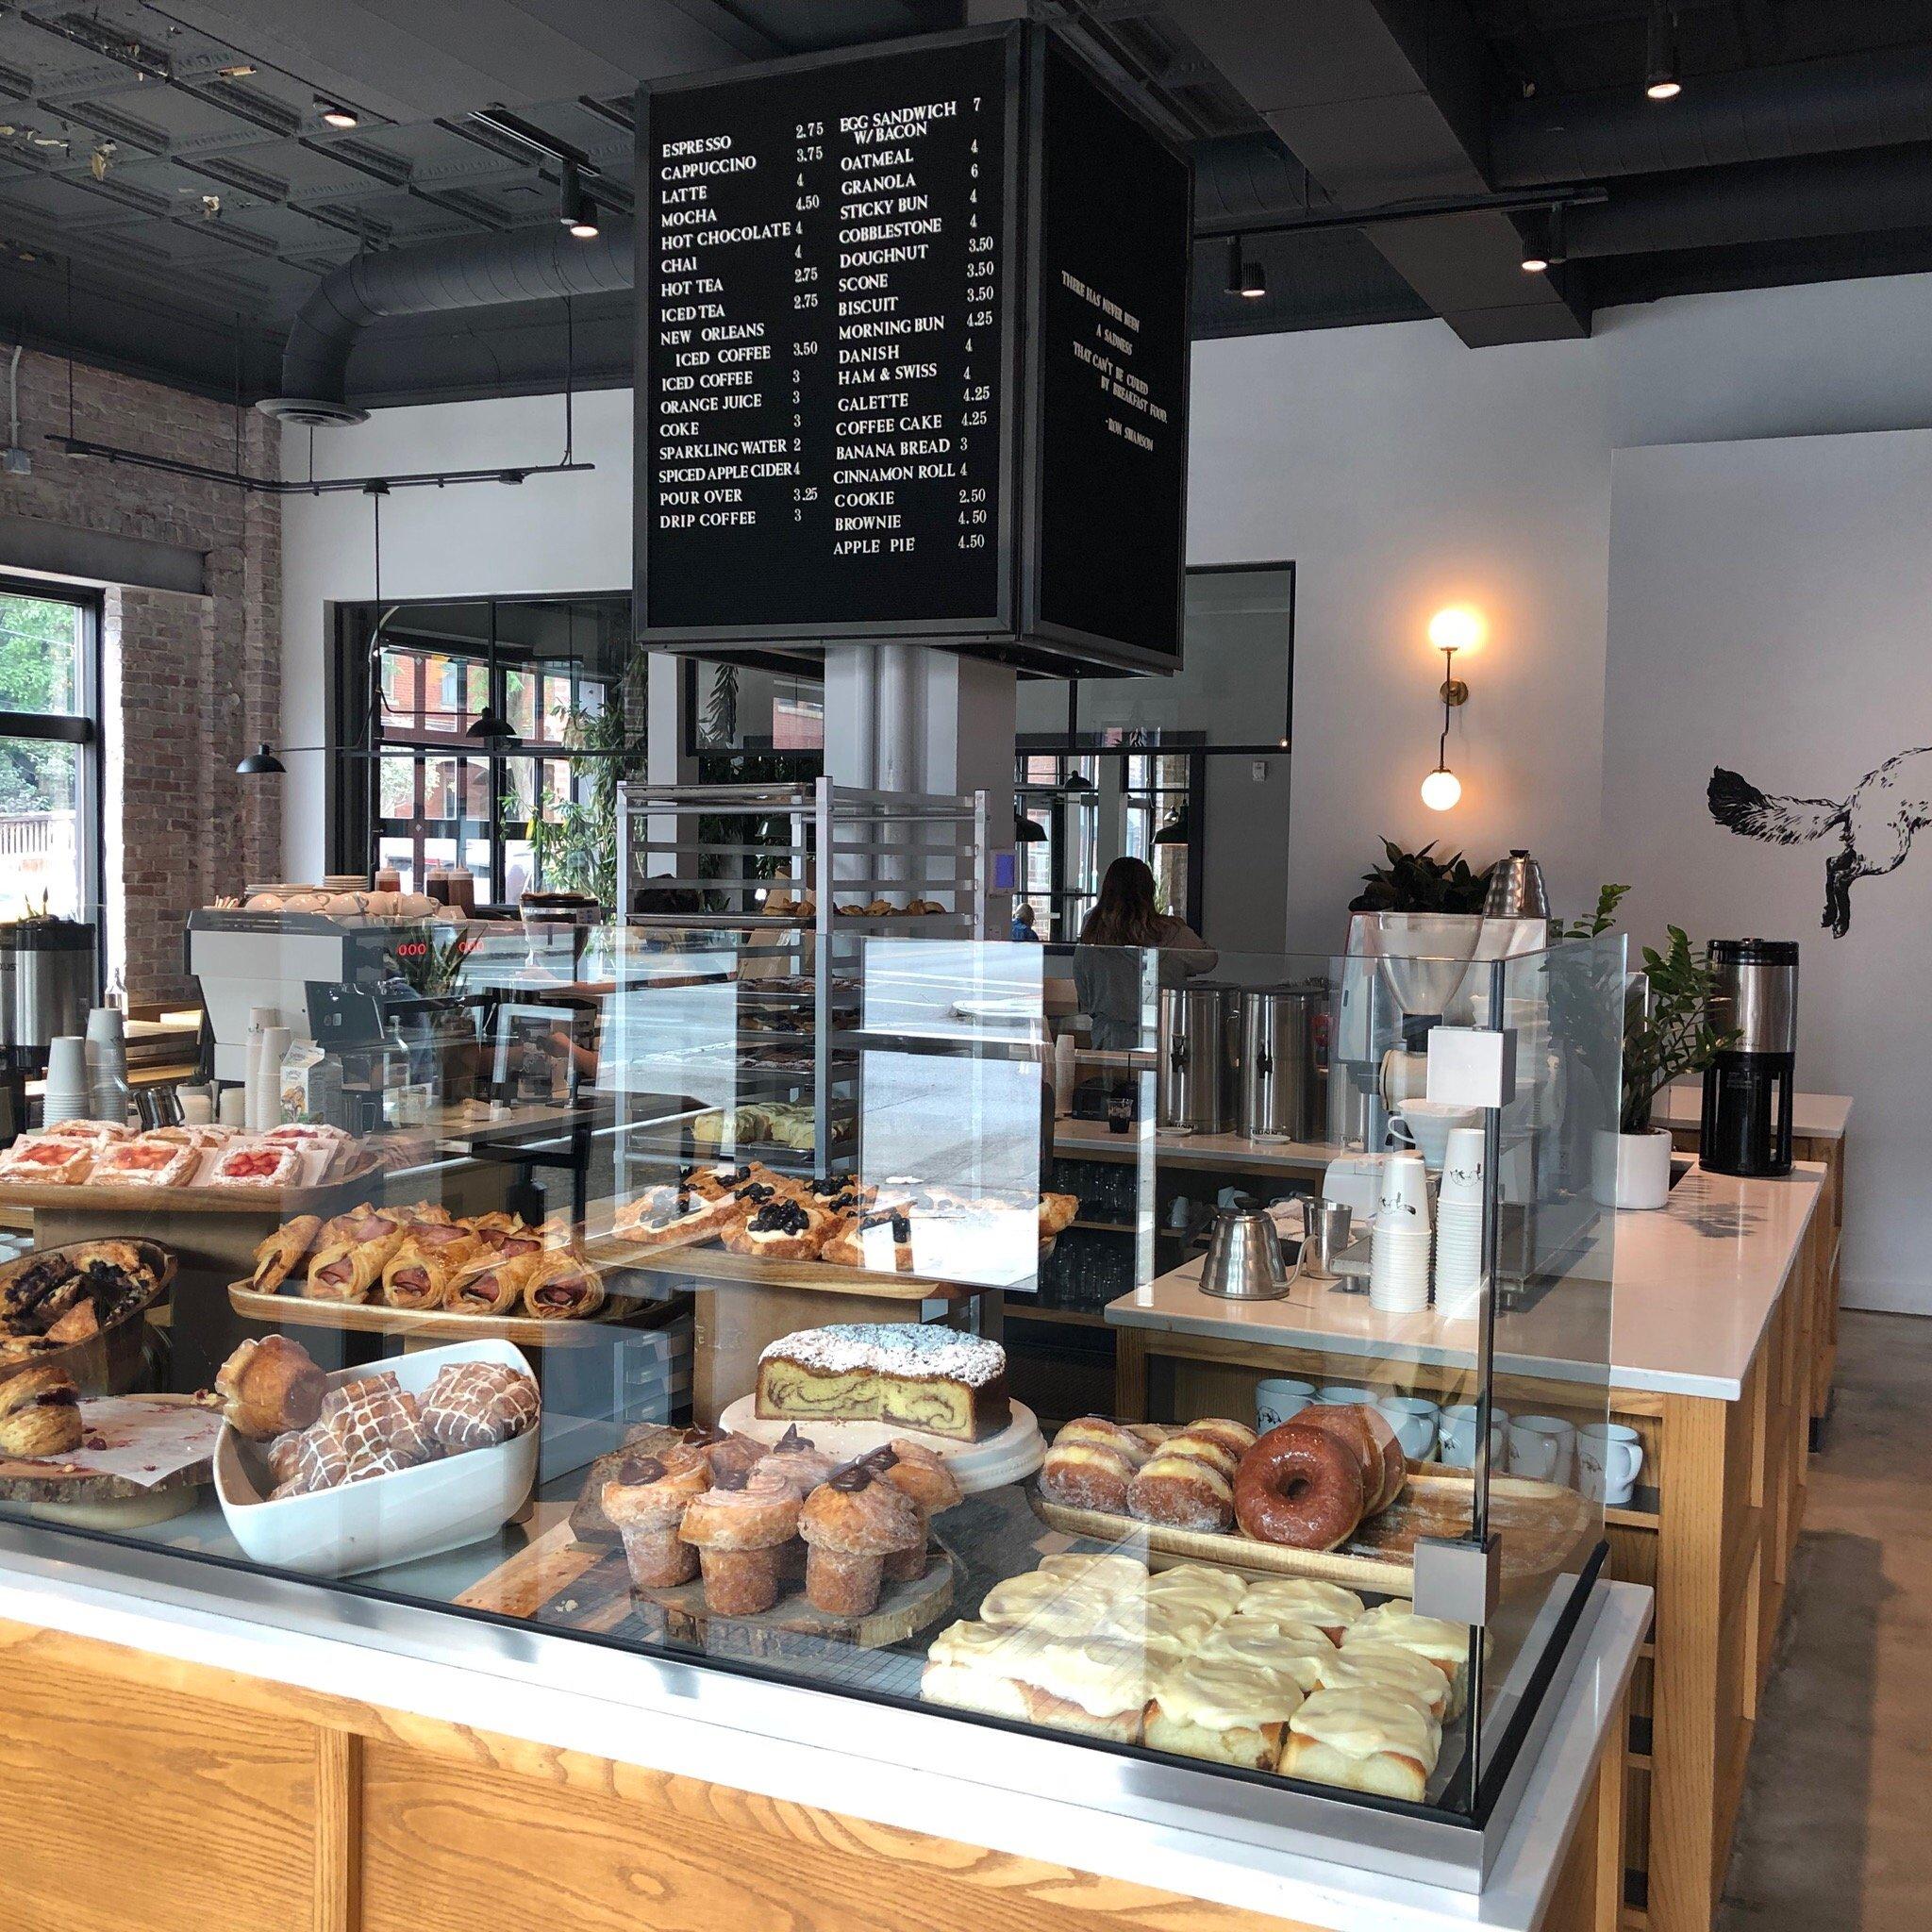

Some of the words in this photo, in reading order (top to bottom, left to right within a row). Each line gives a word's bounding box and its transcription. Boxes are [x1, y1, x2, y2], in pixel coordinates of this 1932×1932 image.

[841, 115, 868, 132] EGG
[873, 101, 957, 126] SANDWICH
[974, 97, 980, 111] 7
[663, 136, 731, 158] ESPRESSO
[796, 122, 824, 139] 2.75
[661, 156, 757, 180] CAPPUCCINO
[797, 145, 823, 162] 3.75
[841, 148, 913, 171] OATMEAL
[971, 140, 978, 153] 4
[662, 186, 707, 204] LATTE
[797, 173, 804, 186] 4
[841, 173, 916, 195] GRANOLA
[971, 163, 978, 177] 6
[661, 208, 717, 227] MOCHA
[796, 194, 819, 210] 4.50
[841, 200, 893, 220] STICKY
[899, 194, 927, 212] BUN
[970, 189, 977, 203] 4
[661, 234, 693, 250] HOT
[697, 222, 791, 245] CHOCOLATE
[795, 221, 803, 234] 4
[839, 218, 941, 243] COBBLESTONE
[970, 214, 977, 227] 4
[661, 257, 697, 273] CHAI
[795, 244, 802, 258] 4
[840, 244, 928, 268] DOUGHNUT
[969, 236, 993, 253] 3.50
[661, 281, 692, 297] HOT
[696, 278, 724, 293] TEA
[795, 267, 818, 283] 2.75
[839, 274, 888, 291] SCONE
[967, 261, 994, 277] 3.50
[661, 307, 696, 323] ICED
[698, 304, 725, 318] TEA
[794, 293, 818, 309] 2.75
[839, 296, 898, 316] BISCUIT
[967, 286, 993, 302] 3.50
[1087, 287, 1102, 308] HAS
[661, 330, 691, 345] NEW
[701, 323, 764, 341] ORLEANS
[840, 320, 911, 340] MORNING
[915, 315, 944, 332] BUN
[967, 310, 992, 326] 4.25
[676, 352, 709, 367] ICED
[718, 345, 771, 363] COFFEE
[793, 341, 817, 356] 3.50
[839, 344, 899, 364] DANISH
[965, 339, 973, 352] 4
[1096, 324, 1102, 338] A
[1104, 328, 1133, 357] SADNESS
[662, 376, 694, 391] ICED
[700, 371, 753, 388] COFFEE
[792, 370, 800, 383] 3
[839, 369, 874, 385] HAM
[880, 368, 890, 381] &
[895, 363, 937, 379] SWISS
[963, 366, 971, 379] 4
[1074, 341, 1092, 364] THAT
[1092, 353, 1113, 376] CAN'T
[1115, 366, 1124, 382] BE
[1126, 374, 1149, 395] CURED
[660, 397, 718, 414] ORANGE
[723, 393, 761, 409] JUICE
[792, 391, 800, 404] 3
[838, 393, 908, 411] GALETTE
[963, 386, 990, 401] 4.25
[1101, 375, 1110, 391] BY
[1113, 382, 1149, 413] BREAKFAST
[660, 422, 699, 437] COKE
[794, 414, 801, 427] 3
[836, 419, 894, 436] COFFEE
[900, 414, 941, 431] CAKE
[961, 411, 987, 425] 4.25
[659, 442, 739, 459] SPARKLING
[741, 439, 787, 454] WATER
[794, 438, 801, 451] 2
[837, 443, 895, 459] BANANA
[901, 439, 950, 455] BREAD
[960, 437, 967, 450] 3
[1124, 426, 1154, 452] SWANSON
[659, 468, 706, 483] SPICED
[708, 465, 748, 480] APPLE
[751, 462, 792, 477] CIDER
[793, 462, 800, 475] 4
[833, 466, 913, 484] CINNAMON
[919, 463, 956, 478] ROLL
[960, 462, 967, 475] 4
[660, 491, 700, 506] POUR
[704, 489, 742, 503] OVER
[793, 488, 817, 501] 3.25
[835, 491, 894, 508] COOKIE
[959, 489, 985, 503] 2.50
[660, 514, 695, 528] DRIP
[700, 511, 756, 526] COFFEE
[794, 508, 801, 522] 3
[836, 515, 901, 531] BROWNIE
[958, 509, 987, 525] 4.50
[834, 540, 880, 555] APPLE
[891, 537, 915, 552] PIE
[958, 534, 984, 548] 4.50
